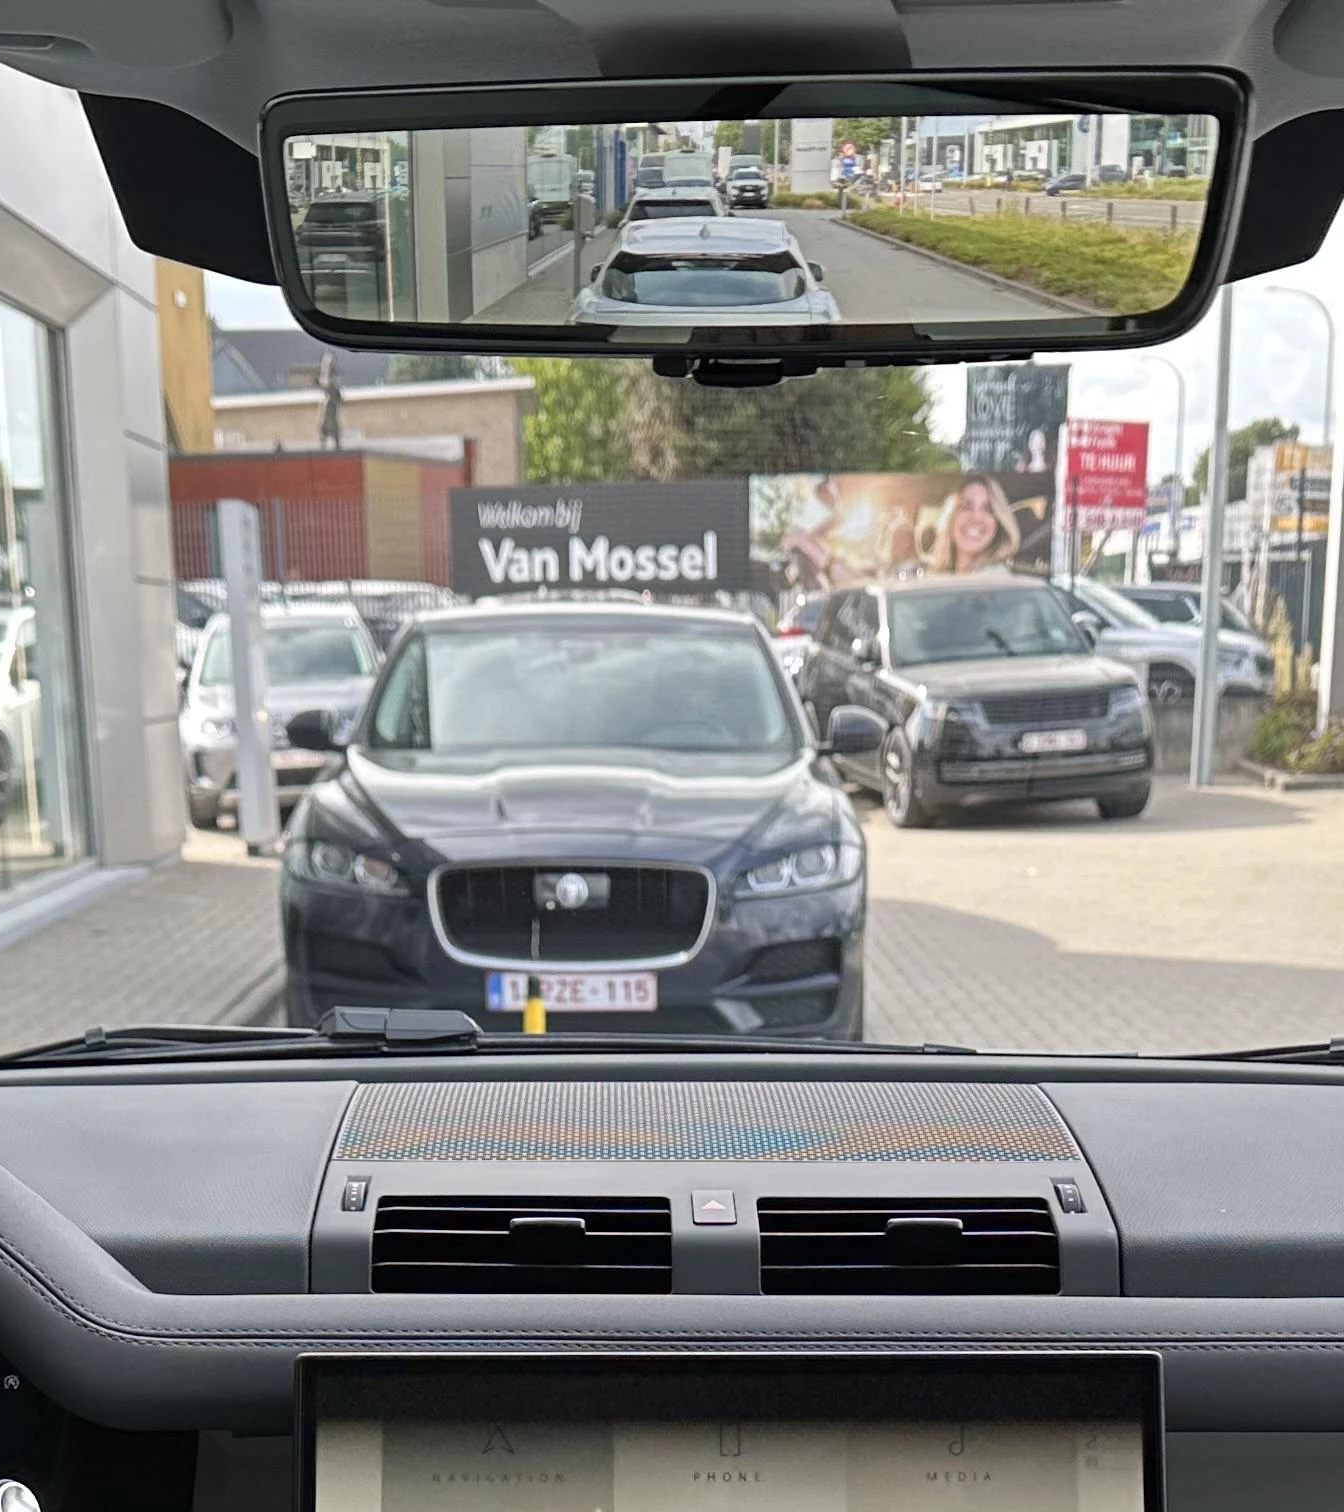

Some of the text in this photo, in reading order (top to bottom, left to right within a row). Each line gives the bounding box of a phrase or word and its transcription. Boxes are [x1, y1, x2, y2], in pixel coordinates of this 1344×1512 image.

[556, 498, 584, 534] bij
[477, 530, 718, 584] Van Mossel
[432, 1474, 565, 1483] NAVIGATION
[693, 1472, 761, 1482] PHONE
[926, 1471, 992, 1481] MEDIA
